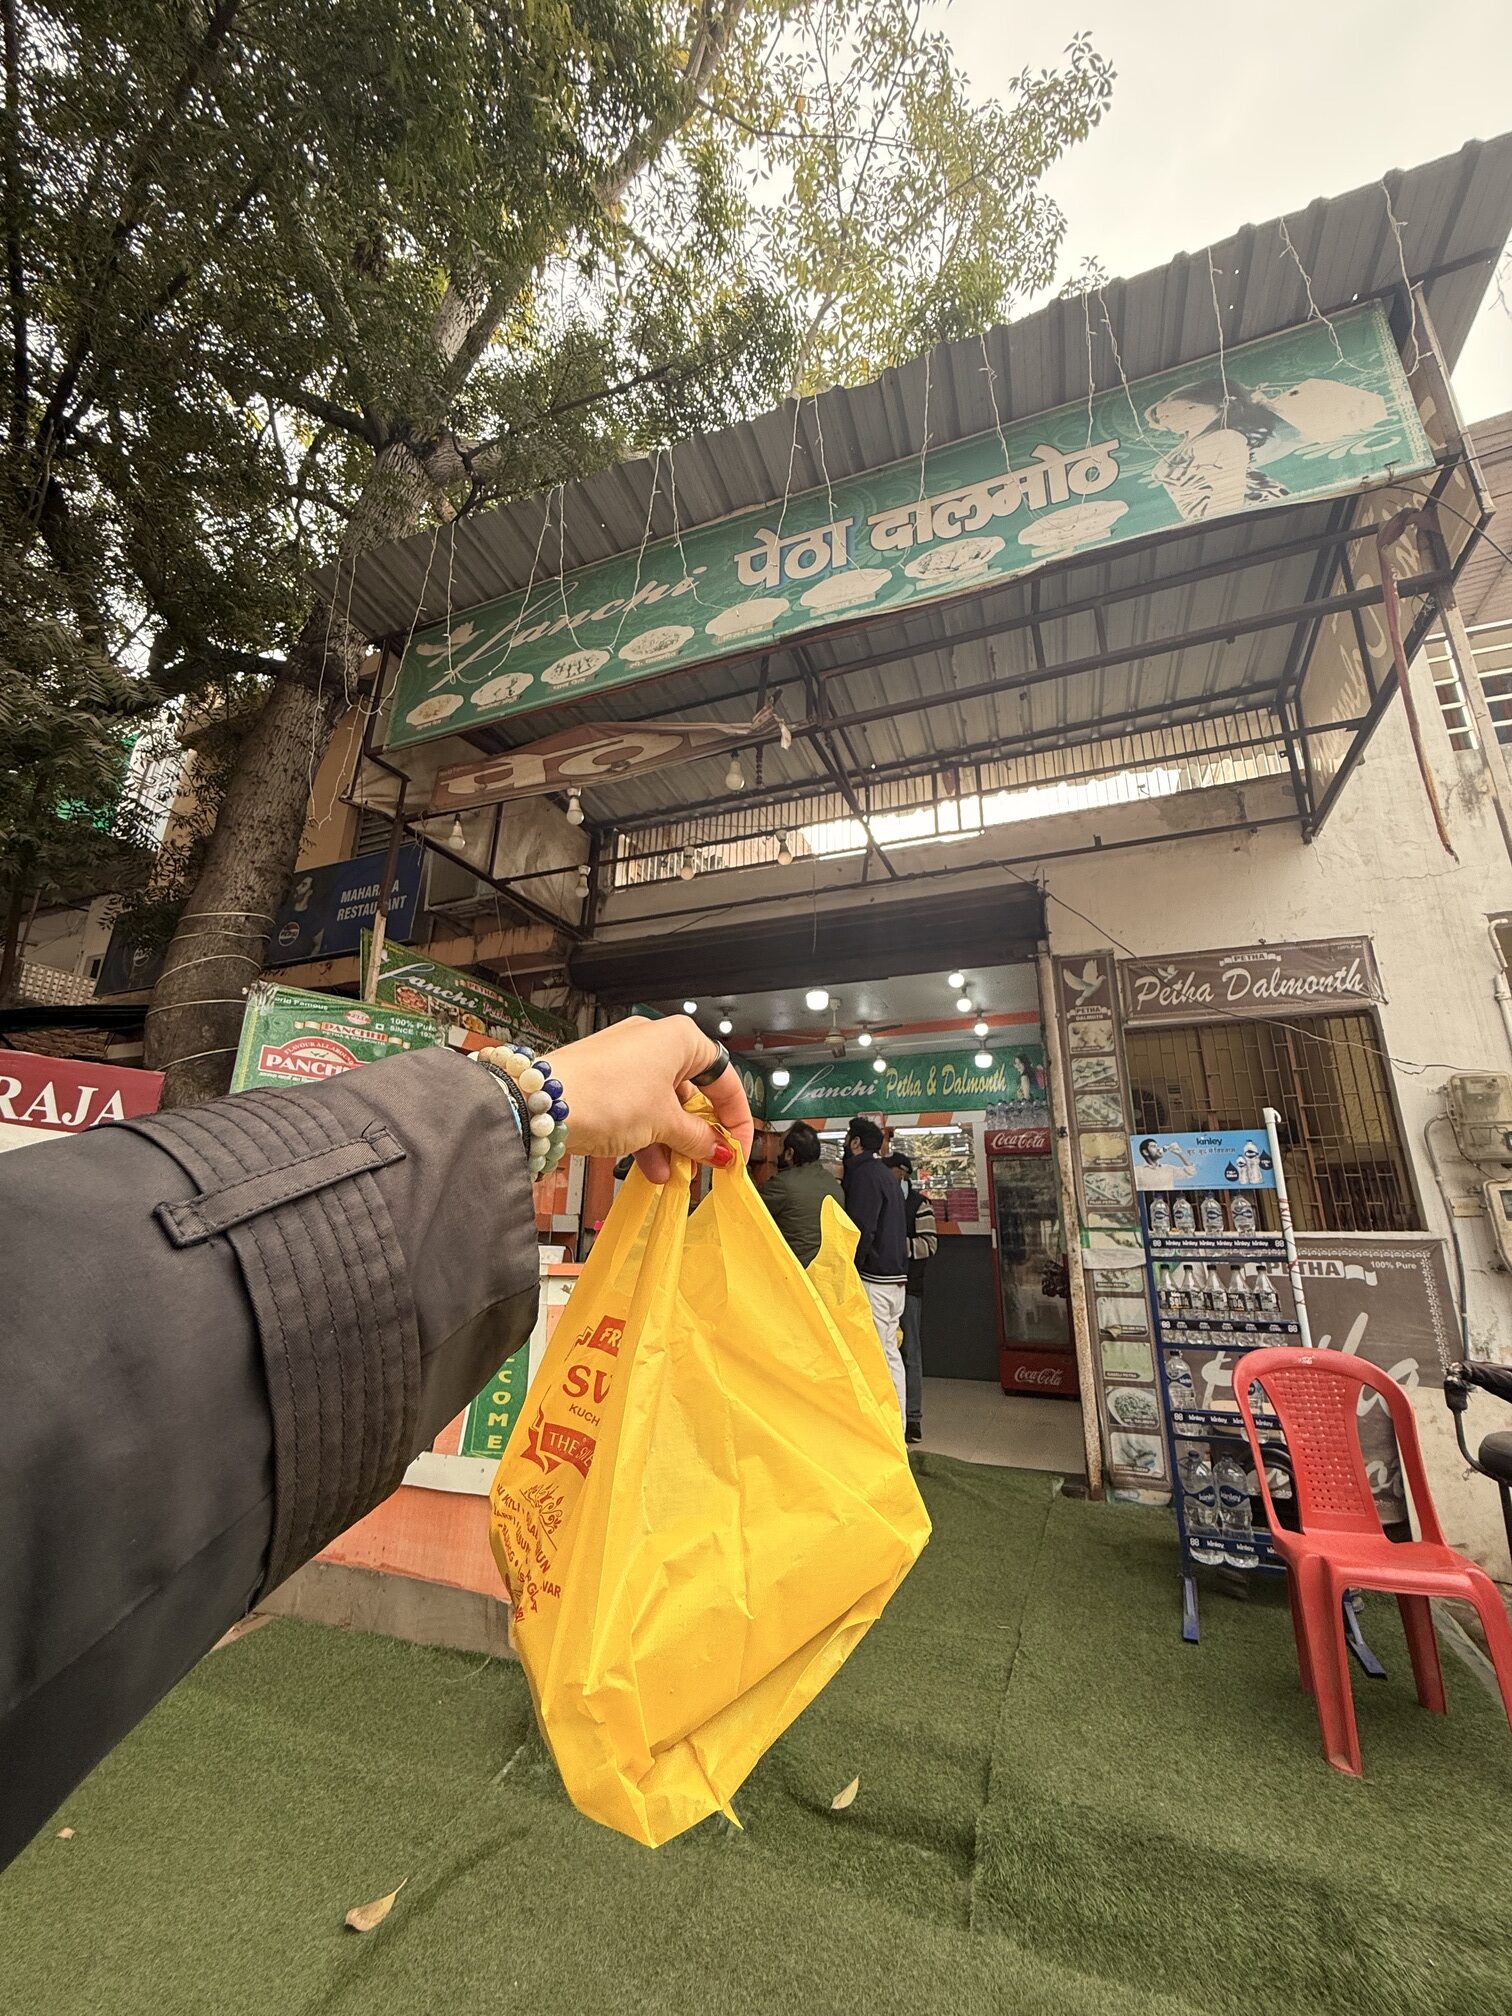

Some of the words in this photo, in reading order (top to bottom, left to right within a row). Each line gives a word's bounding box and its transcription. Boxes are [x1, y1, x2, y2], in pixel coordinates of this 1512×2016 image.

[734, 518, 853, 588] पेठा
[867, 438, 1120, 552] दालमोठ
[341, 879, 399, 903] MAHARA
[336, 895, 407, 921] RESTAUANT
[1234, 953, 1265, 962] PETHA
[1135, 970, 1214, 1010] Petha
[1222, 958, 1363, 1001] Dalmonth
[389, 1025, 414, 1035] SINCE
[390, 1016, 414, 1028] 100%
[284, 1042, 316, 1055] FLAVOUR
[885, 1067, 922, 1099] Petha
[926, 1065, 937, 1097] &
[942, 1063, 1007, 1097] Dalmonth
[1196, 1136, 1223, 1147] kinley
[1371, 1261, 1394, 1270] 100%
[1396, 1261, 1417, 1270] Pure
[600, 1327, 621, 1348] FR
[549, 1431, 580, 1455] THE
